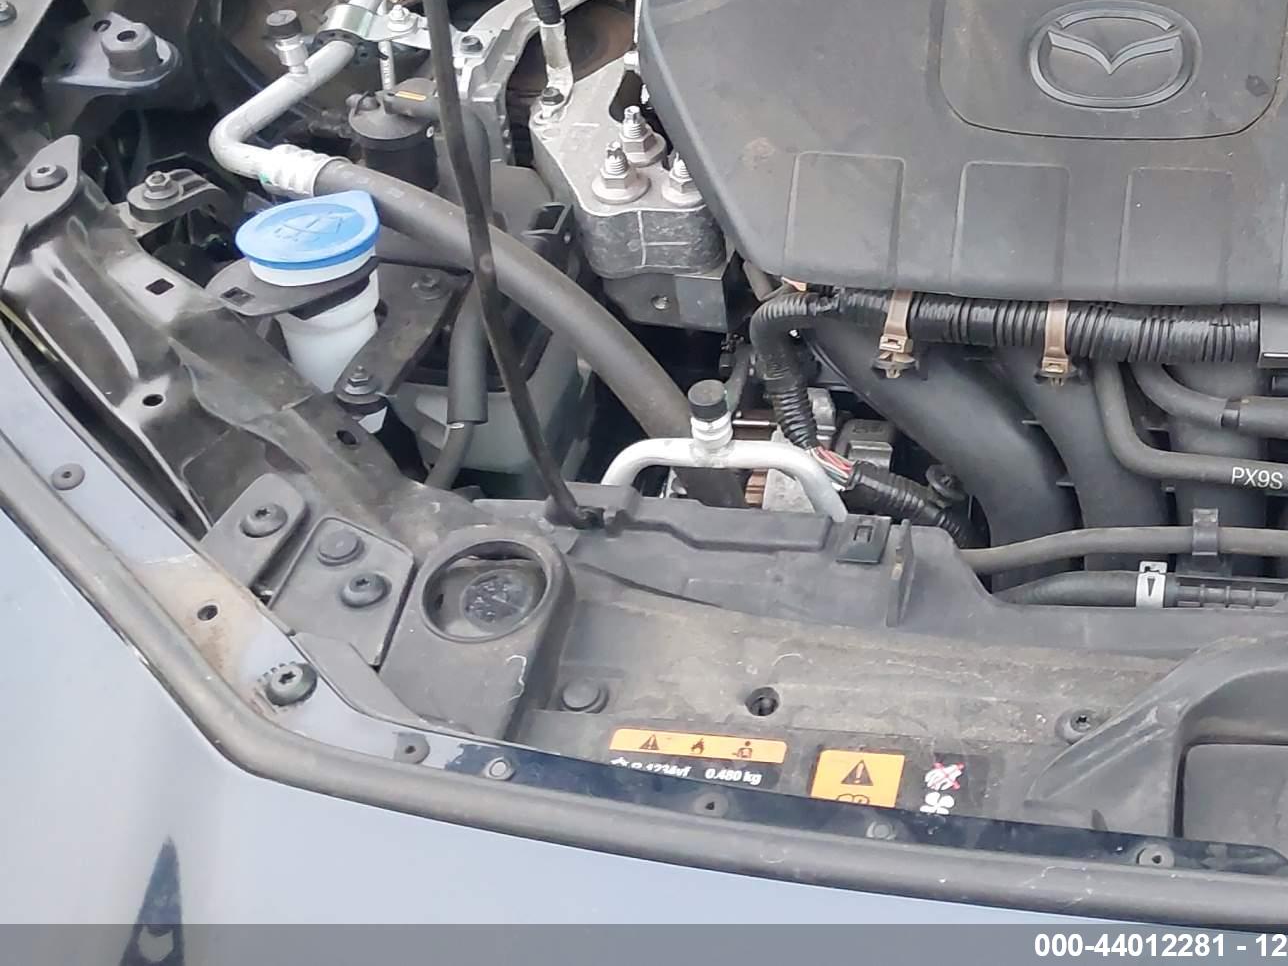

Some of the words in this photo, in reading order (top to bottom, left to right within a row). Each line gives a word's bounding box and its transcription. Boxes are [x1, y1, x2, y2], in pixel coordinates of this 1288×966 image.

[1231, 466, 1284, 490] PX9S
[704, 768, 741, 782] 0.480
[743, 772, 763, 786] kg
